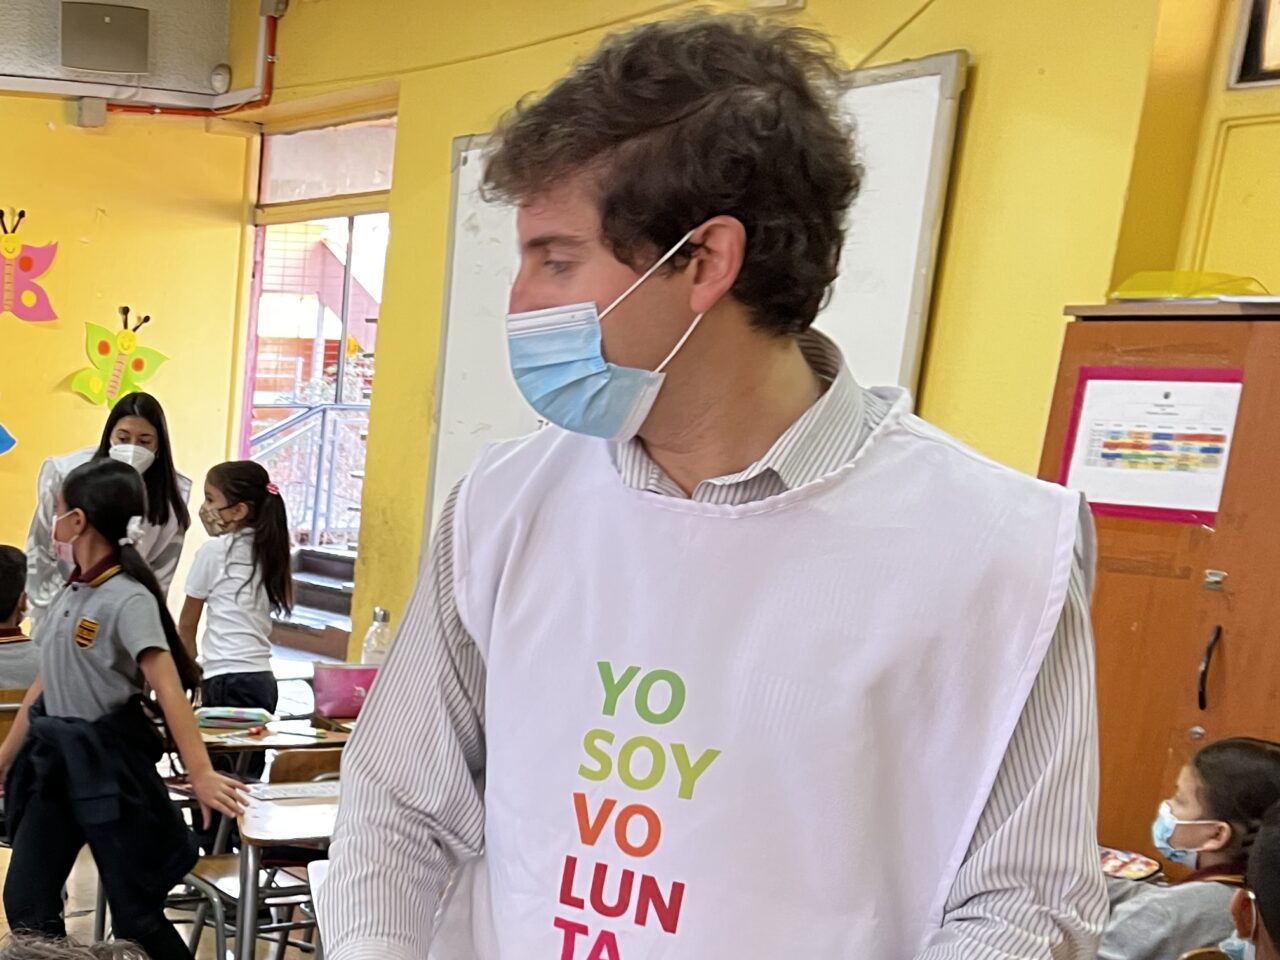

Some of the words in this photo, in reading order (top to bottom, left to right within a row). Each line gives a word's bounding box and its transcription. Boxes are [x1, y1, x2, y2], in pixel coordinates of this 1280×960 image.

[596, 660, 686, 725] YO
[577, 727, 722, 801] SOY
[572, 791, 663, 858] VO
[558, 854, 686, 935] LUN
